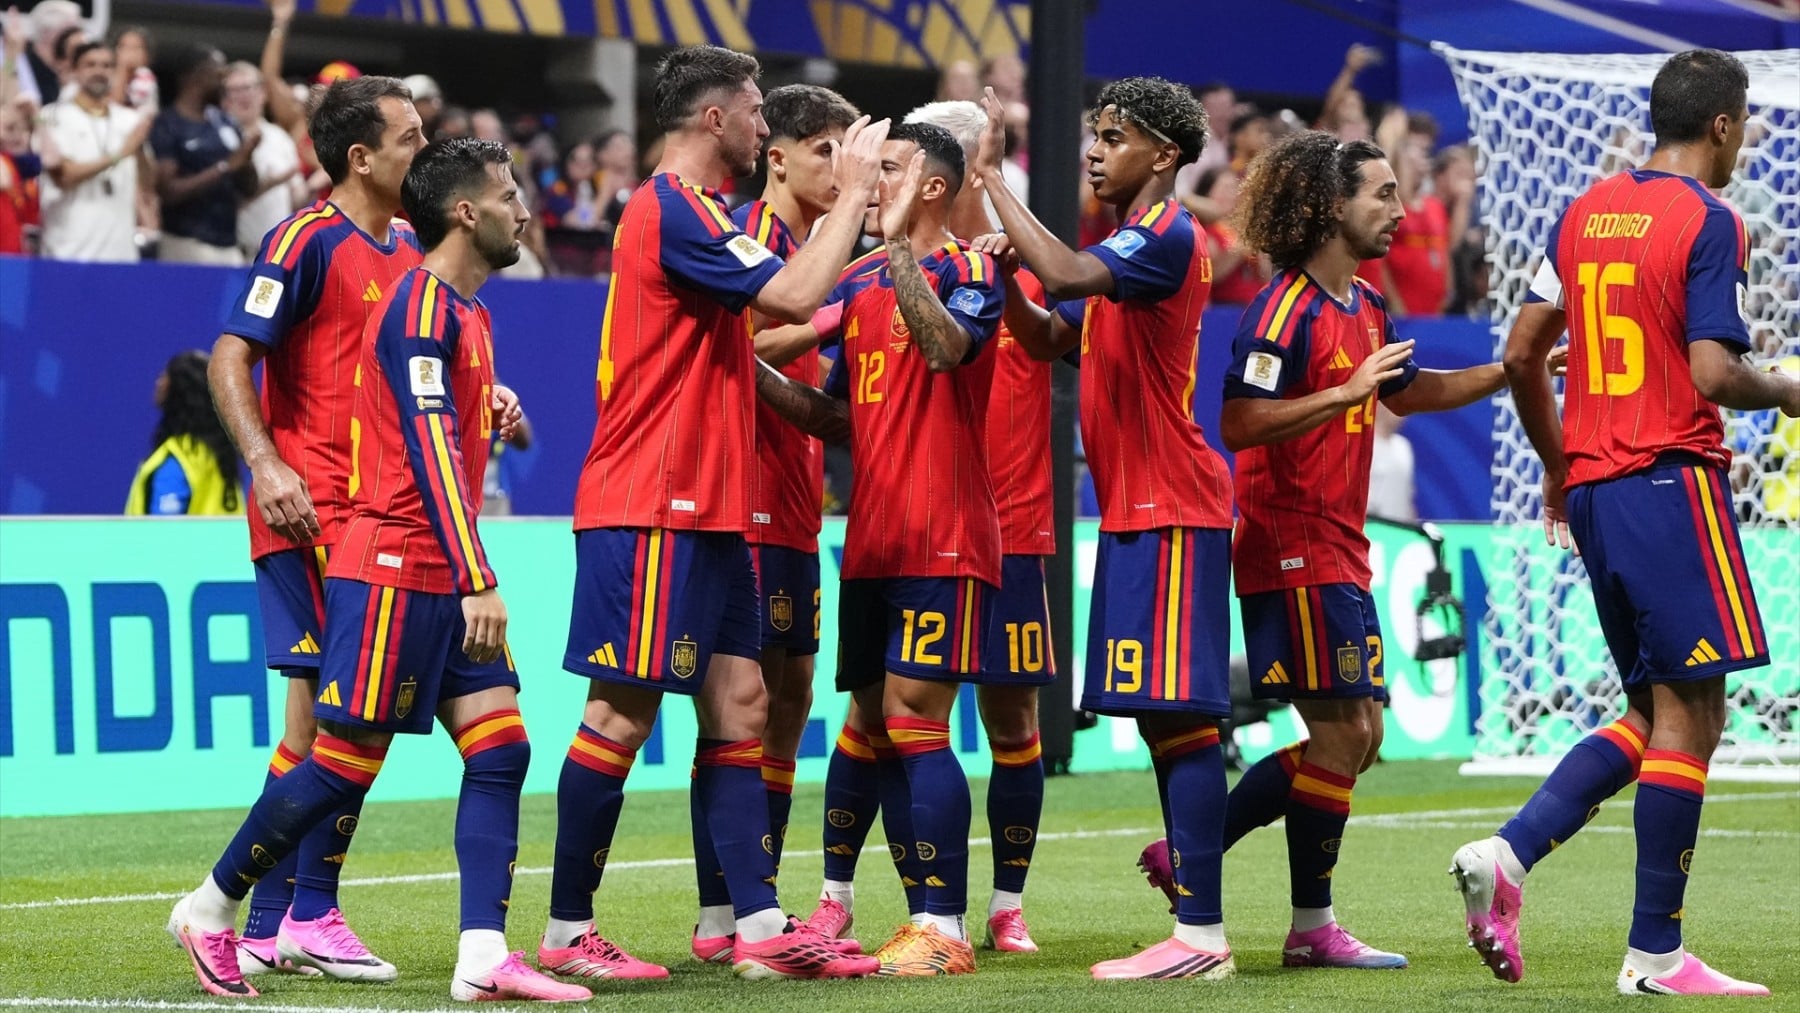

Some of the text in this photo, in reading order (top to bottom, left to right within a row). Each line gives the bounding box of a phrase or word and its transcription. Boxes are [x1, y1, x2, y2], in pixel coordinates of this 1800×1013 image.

[1583, 213, 1653, 238] RODRIGO
[1578, 262, 1645, 396] 16
[858, 350, 885, 404] 12
[901, 609, 946, 665] 12
[1005, 621, 1042, 673] 10
[1105, 638, 1143, 692] 19
